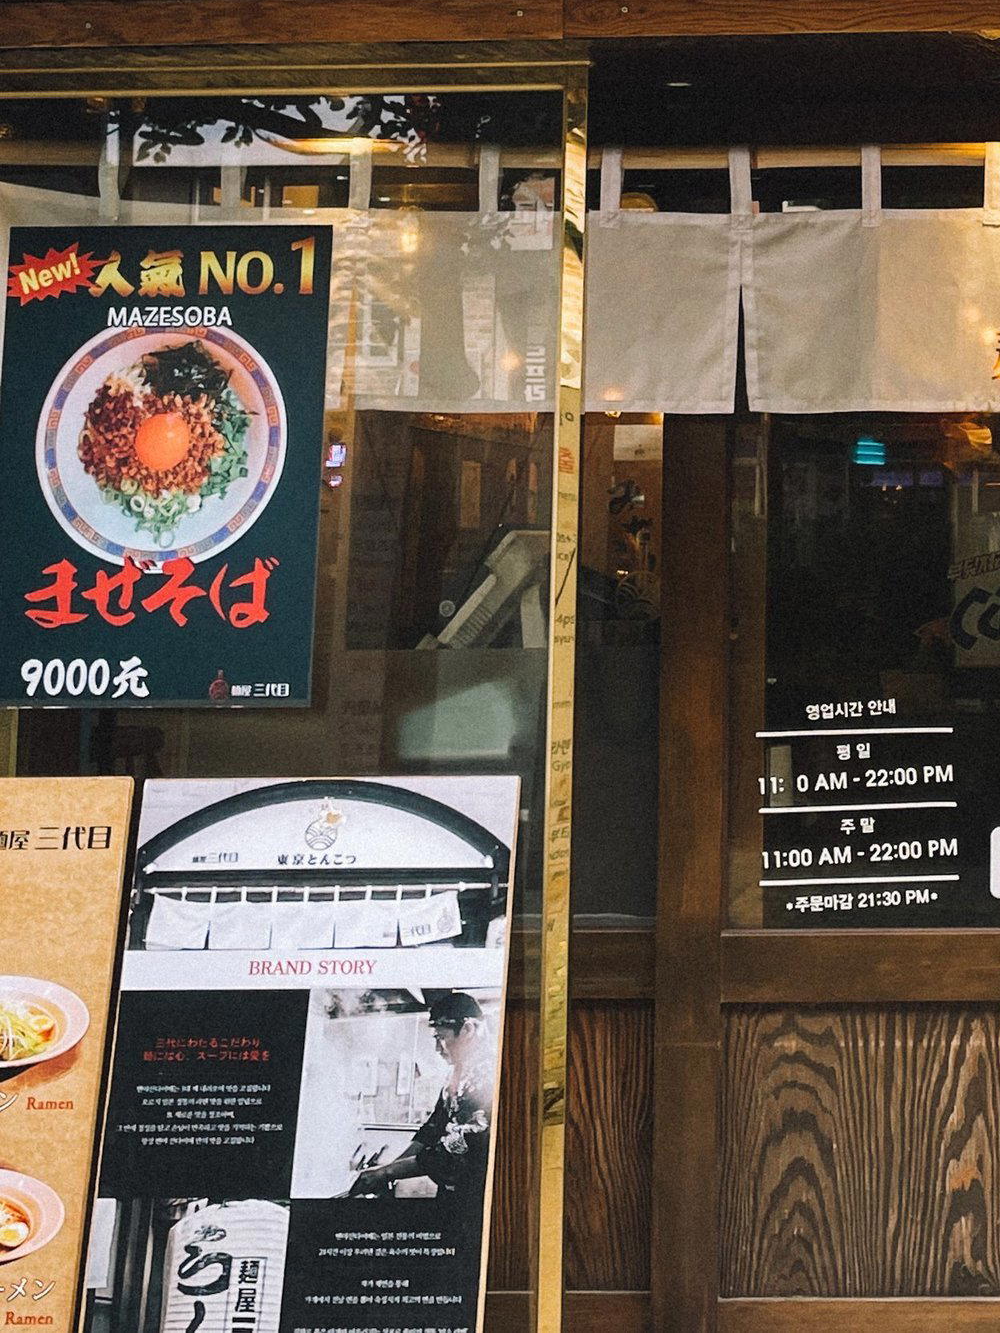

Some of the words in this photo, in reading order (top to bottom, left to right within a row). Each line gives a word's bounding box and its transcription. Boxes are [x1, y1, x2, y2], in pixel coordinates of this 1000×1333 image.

[19, 253, 82, 293] New!
[107, 304, 233, 328] MAZESOBA
[24, 555, 281, 629] まぜそば
[805, 702, 864, 721] 영업시간
[867, 698, 897, 716] 안내
[814, 771, 848, 792] AM
[864, 767, 918, 788] 22:00
[923, 764, 954, 784] PM
[762, 848, 813, 869] 11:00
[818, 845, 852, 865] AM
[869, 840, 923, 862] 22:00
[927, 838, 959, 858] PM
[858, 890, 901, 908] 21:30
[248, 959, 312, 976] BRAND
[318, 958, 378, 976] STORY
[26, 1096, 74, 1111] Ramen
[4, 1311, 54, 1327] Ramen
